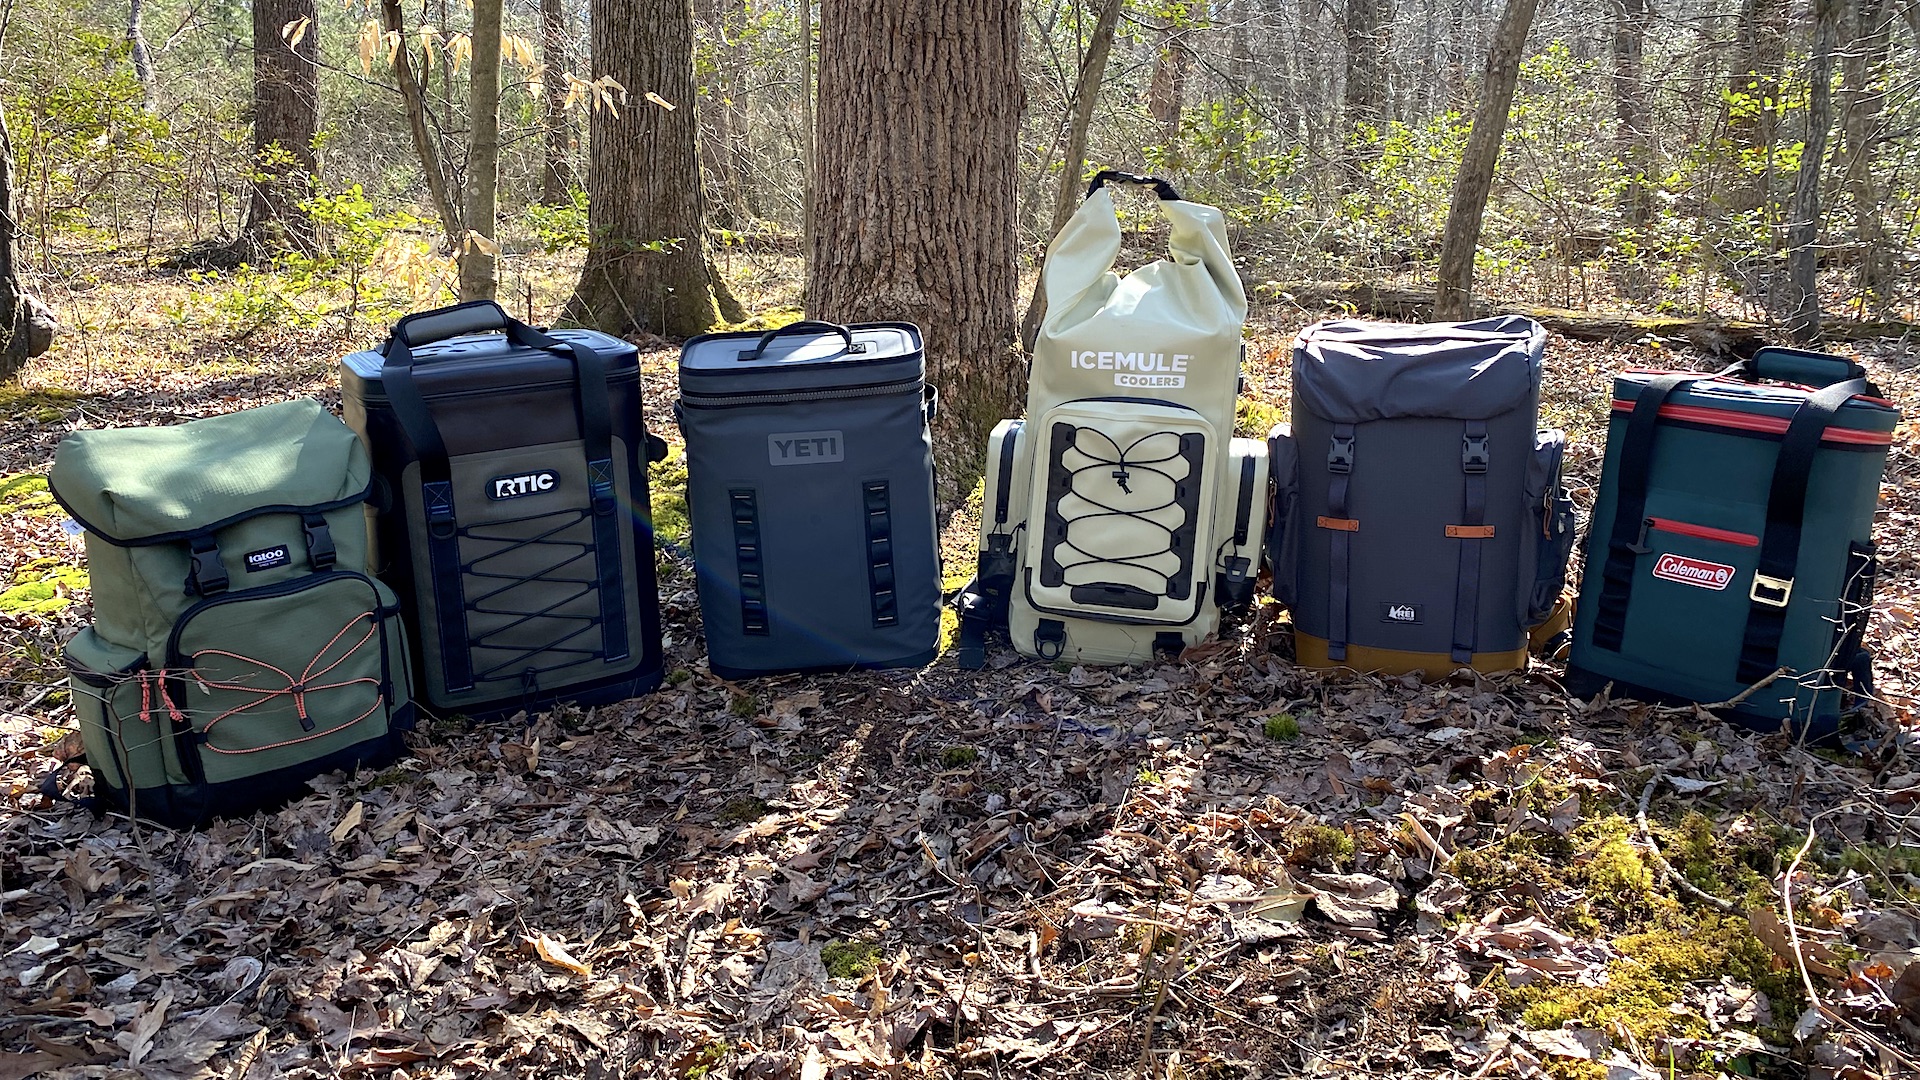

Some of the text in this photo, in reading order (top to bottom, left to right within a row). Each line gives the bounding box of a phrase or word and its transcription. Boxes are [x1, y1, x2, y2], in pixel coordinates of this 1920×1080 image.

[1071, 350, 1189, 372] ICEMULE
[1120, 375, 1180, 387] COOLERS
[774, 437, 837, 458] YETI
[496, 474, 554, 497] RTIC
[1661, 557, 1716, 581] Coleman
[1396, 610, 1415, 618] REI
